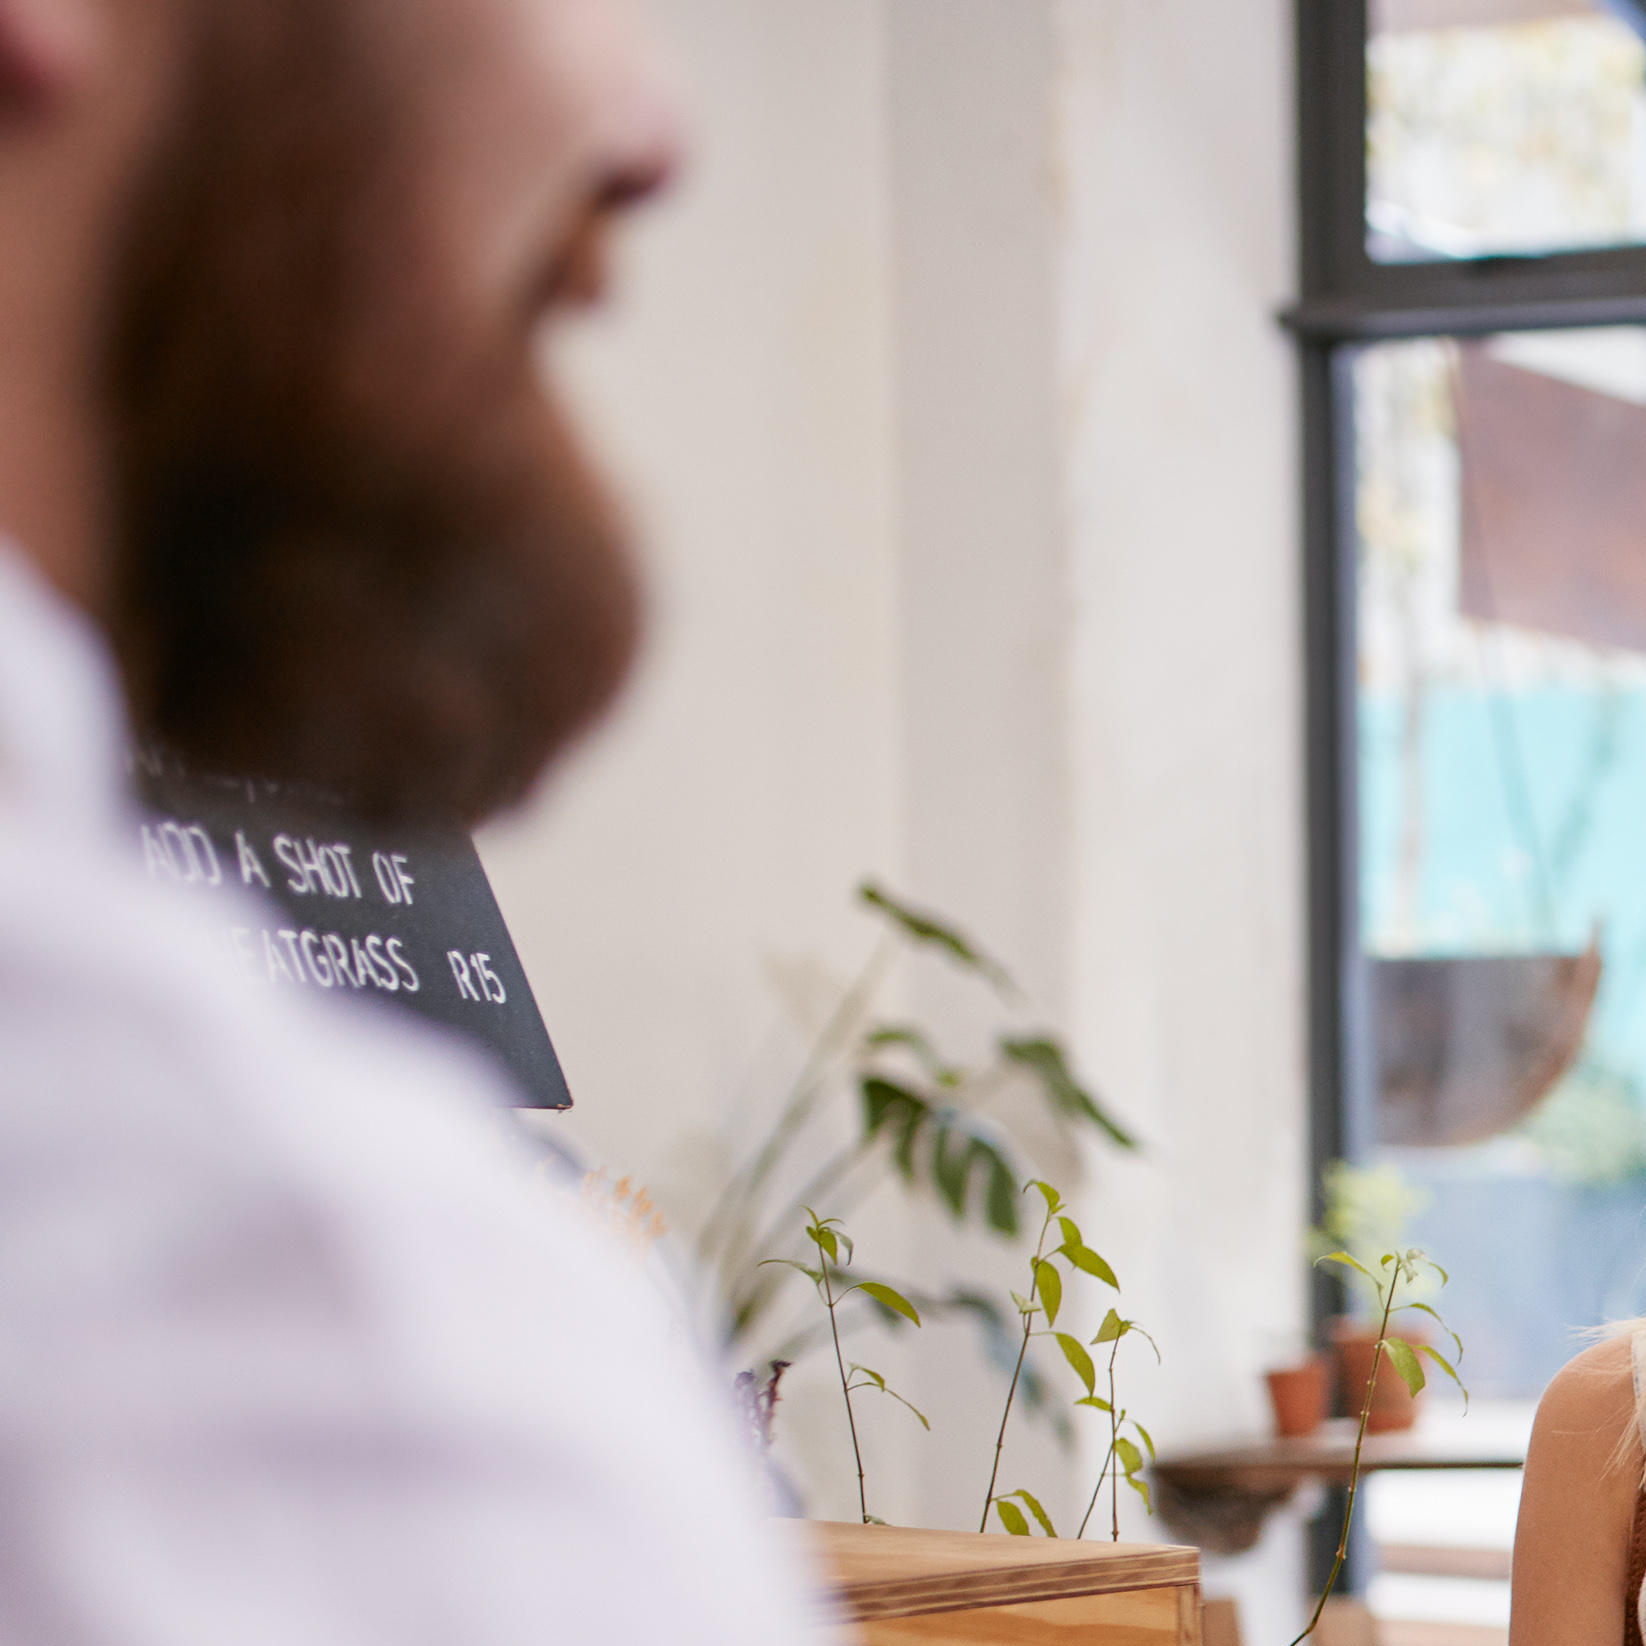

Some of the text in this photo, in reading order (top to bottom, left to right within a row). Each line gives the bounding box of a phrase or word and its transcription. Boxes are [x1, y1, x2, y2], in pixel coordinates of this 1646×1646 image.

[141, 821, 414, 906] ADD A SHOT OF
[212, 928, 508, 1005] EATGRASS R15
